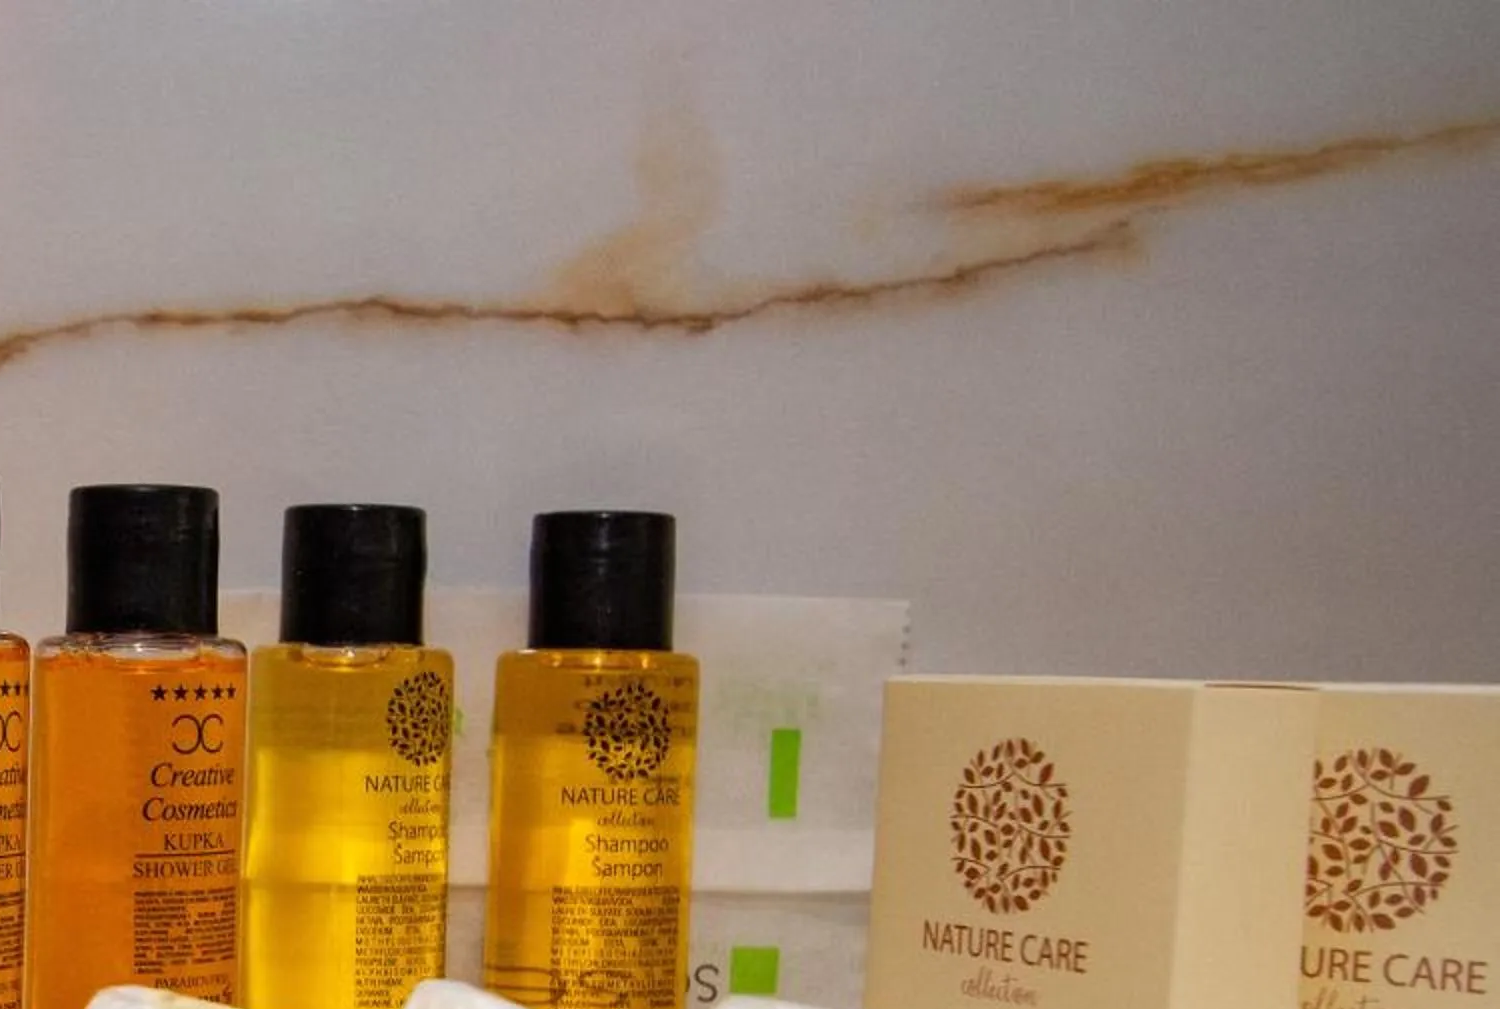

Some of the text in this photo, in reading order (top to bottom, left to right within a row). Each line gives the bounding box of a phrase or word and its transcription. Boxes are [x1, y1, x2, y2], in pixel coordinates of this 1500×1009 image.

[150, 762, 235, 788] Creative
[365, 775, 431, 793] NATURE
[561, 786, 681, 806] NATURE CARE
[163, 832, 224, 851] KUPKA
[585, 834, 669, 855] Shampoo
[132, 860, 214, 879] SHOWER
[592, 857, 663, 879] Šampon
[923, 919, 1089, 974] NATURE CARE
[1299, 945, 1488, 995] URE CARE
